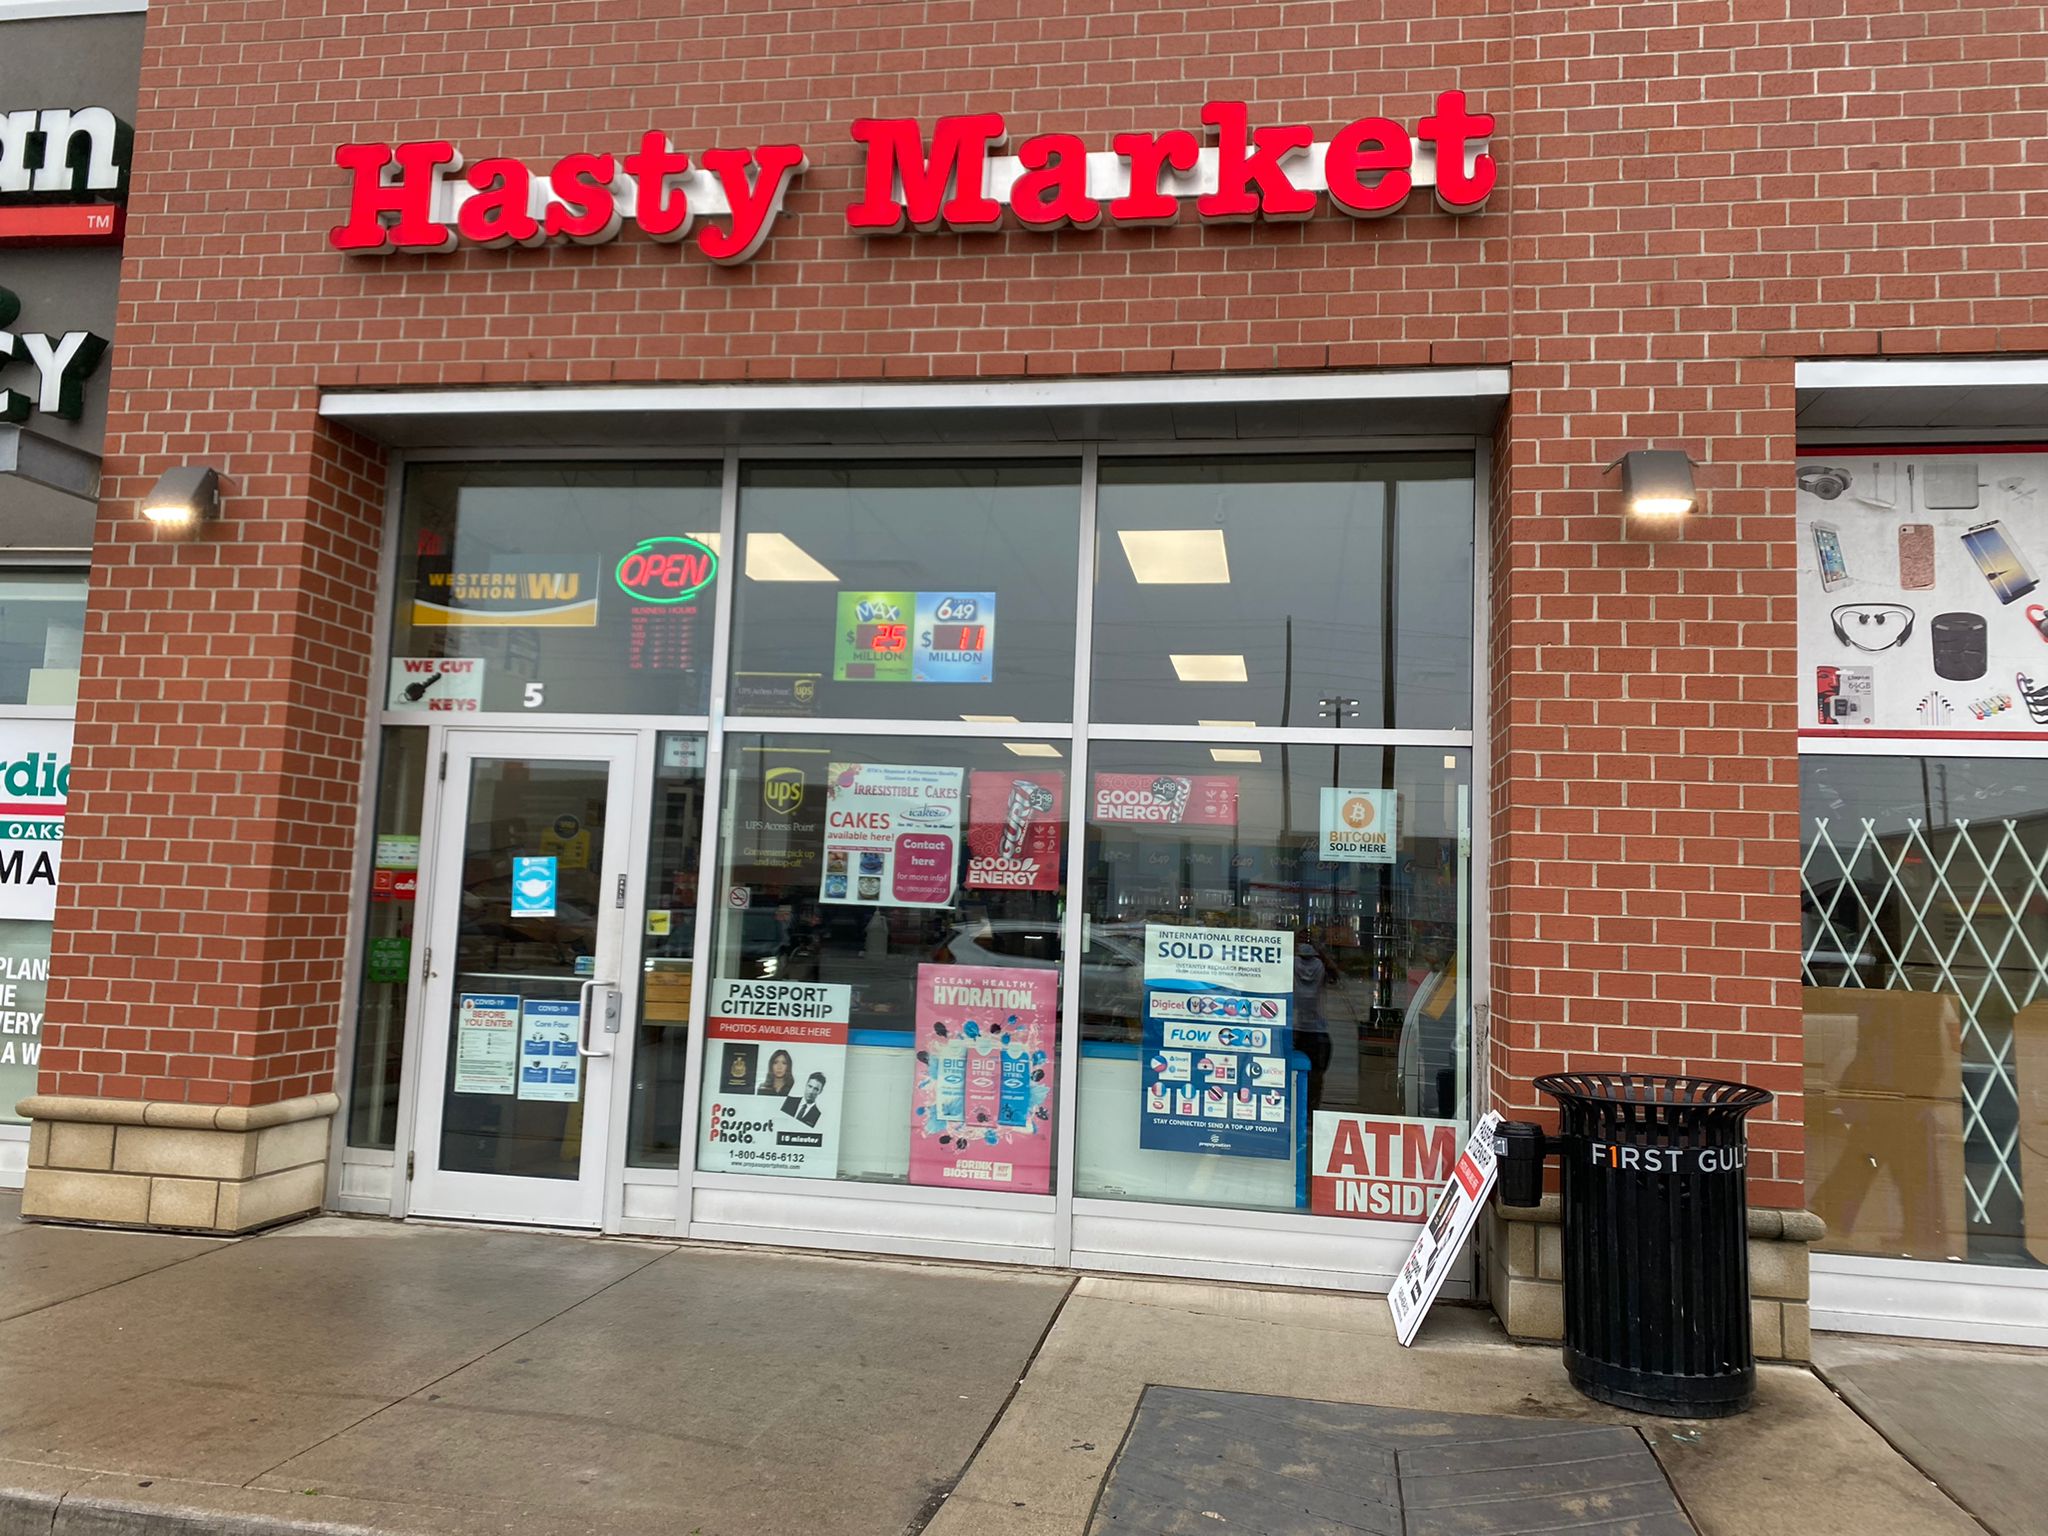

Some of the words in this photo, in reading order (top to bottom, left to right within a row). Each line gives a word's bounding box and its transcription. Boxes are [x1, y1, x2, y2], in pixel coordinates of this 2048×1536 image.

[329, 129, 806, 262] Hasty
[845, 90, 1497, 232] Market
[87, 215, 110, 229] TM
[0, 331, 89, 412] Y
[620, 554, 710, 588] OPEN
[428, 573, 517, 587] WESTERN
[527, 573, 580, 600] WU
[454, 586, 516, 600] UNION
[856, 600, 898, 622] MAX
[853, 652, 903, 662] MILLION
[928, 652, 983, 663] MILLION
[404, 660, 434, 673] WE
[439, 660, 474, 673] CUT
[523, 682, 545, 708] 5
[429, 698, 477, 712] KEYS
[0, 752, 71, 797] di
[766, 781, 801, 807] ups
[1097, 789, 1153, 804] GOOD
[1096, 804, 1171, 821] ENERGY
[745, 820, 763, 831] UPS
[764, 821, 792, 832] Access
[830, 811, 890, 830] CAKES
[8, 823, 65, 840] OAKS
[827, 831, 868, 841] available
[870, 832, 894, 842] here!
[1329, 831, 1387, 844] BITCOIN
[903, 839, 946, 851] Contact
[1329, 842, 1357, 852] SOLD
[1360, 843, 1387, 853] HERE
[911, 855, 935, 866] here
[969, 856, 1022, 871] GOOD
[896, 871, 907, 880] for
[909, 873, 929, 881] more
[969, 870, 1038, 886] ENERGY
[1159, 930, 1231, 942] INTERNATIONAL
[1234, 934, 1282, 945] RECHARGE
[1158, 941, 1213, 959] SOLD
[1221, 944, 1282, 963] HERE!
[0, 957, 50, 981] LAN
[934, 976, 976, 986] CLEAN.
[982, 979, 1038, 989] HEALTHY.
[729, 984, 828, 1002] PASSPORT
[933, 985, 1037, 1010] HYDRATION.
[721, 1000, 833, 1019] CITIZENSHIP
[1151, 1000, 1185, 1011] Digicel
[472, 1011, 505, 1019] BEFORE
[464, 1018, 482, 1026] YOU
[485, 1019, 513, 1028] ENTER
[719, 1022, 757, 1034] PHOTOS
[757, 1024, 806, 1036] AVAILABLE
[807, 1027, 832, 1037] HERE
[1171, 1029, 1212, 1042] FLOW
[711, 1103, 736, 1117] Pro
[710, 1116, 774, 1134] Passport
[1168, 1119, 1207, 1128] CONNECTED!
[1231, 1124, 1254, 1132] TOP-UP
[709, 1128, 753, 1144] Photo
[729, 1149, 805, 1163] 1-800-456-6132
[1326, 1119, 1457, 1183] ATM
[943, 1167, 992, 1180] BIOSTEEL
